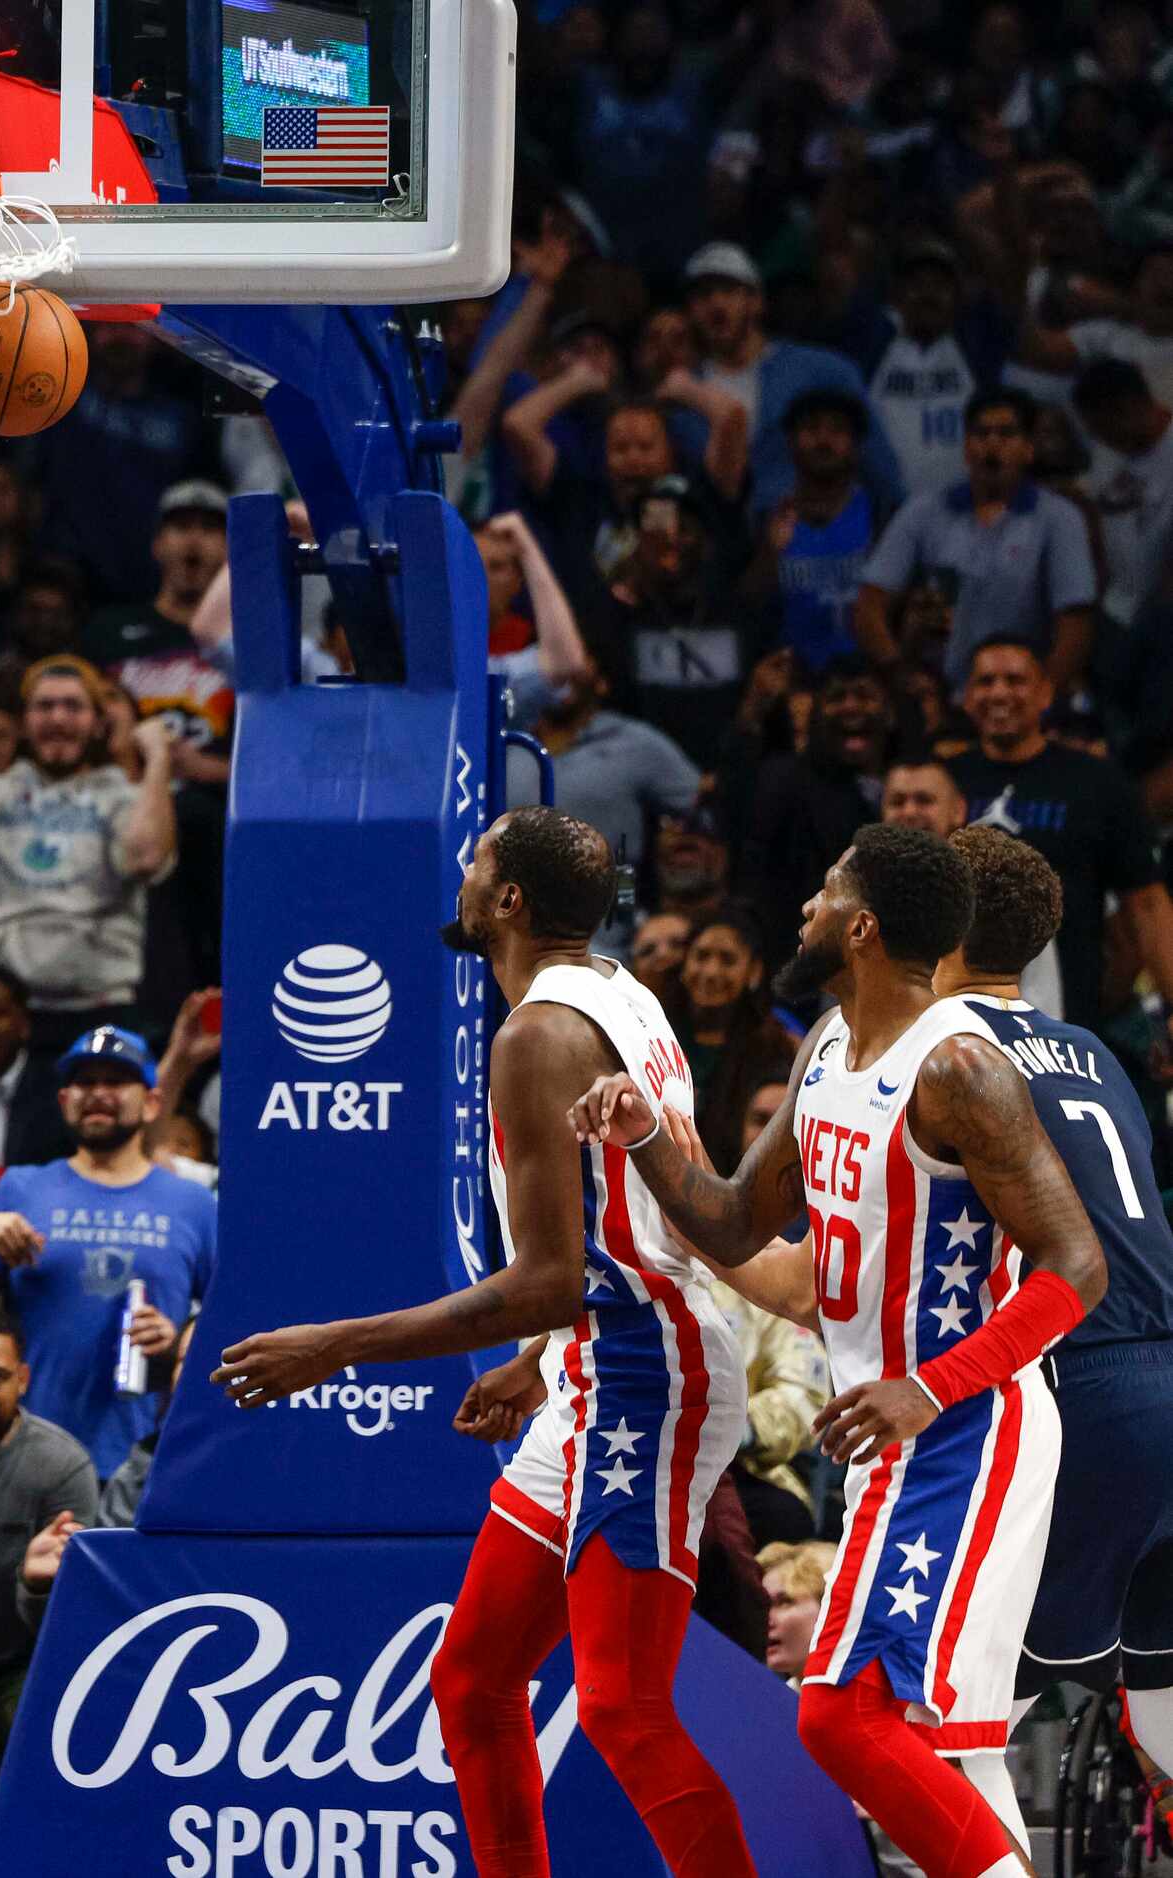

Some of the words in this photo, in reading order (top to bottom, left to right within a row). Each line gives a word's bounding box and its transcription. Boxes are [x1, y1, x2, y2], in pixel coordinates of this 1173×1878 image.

[453, 741, 476, 1239] CHOCAW
[1001, 1037, 1103, 1085] POWELL
[257, 1080, 403, 1131] AT&T
[801, 1113, 871, 1203] NETS
[1059, 1099, 1145, 1220] 7
[167, 1804, 458, 1878] SPORTS
